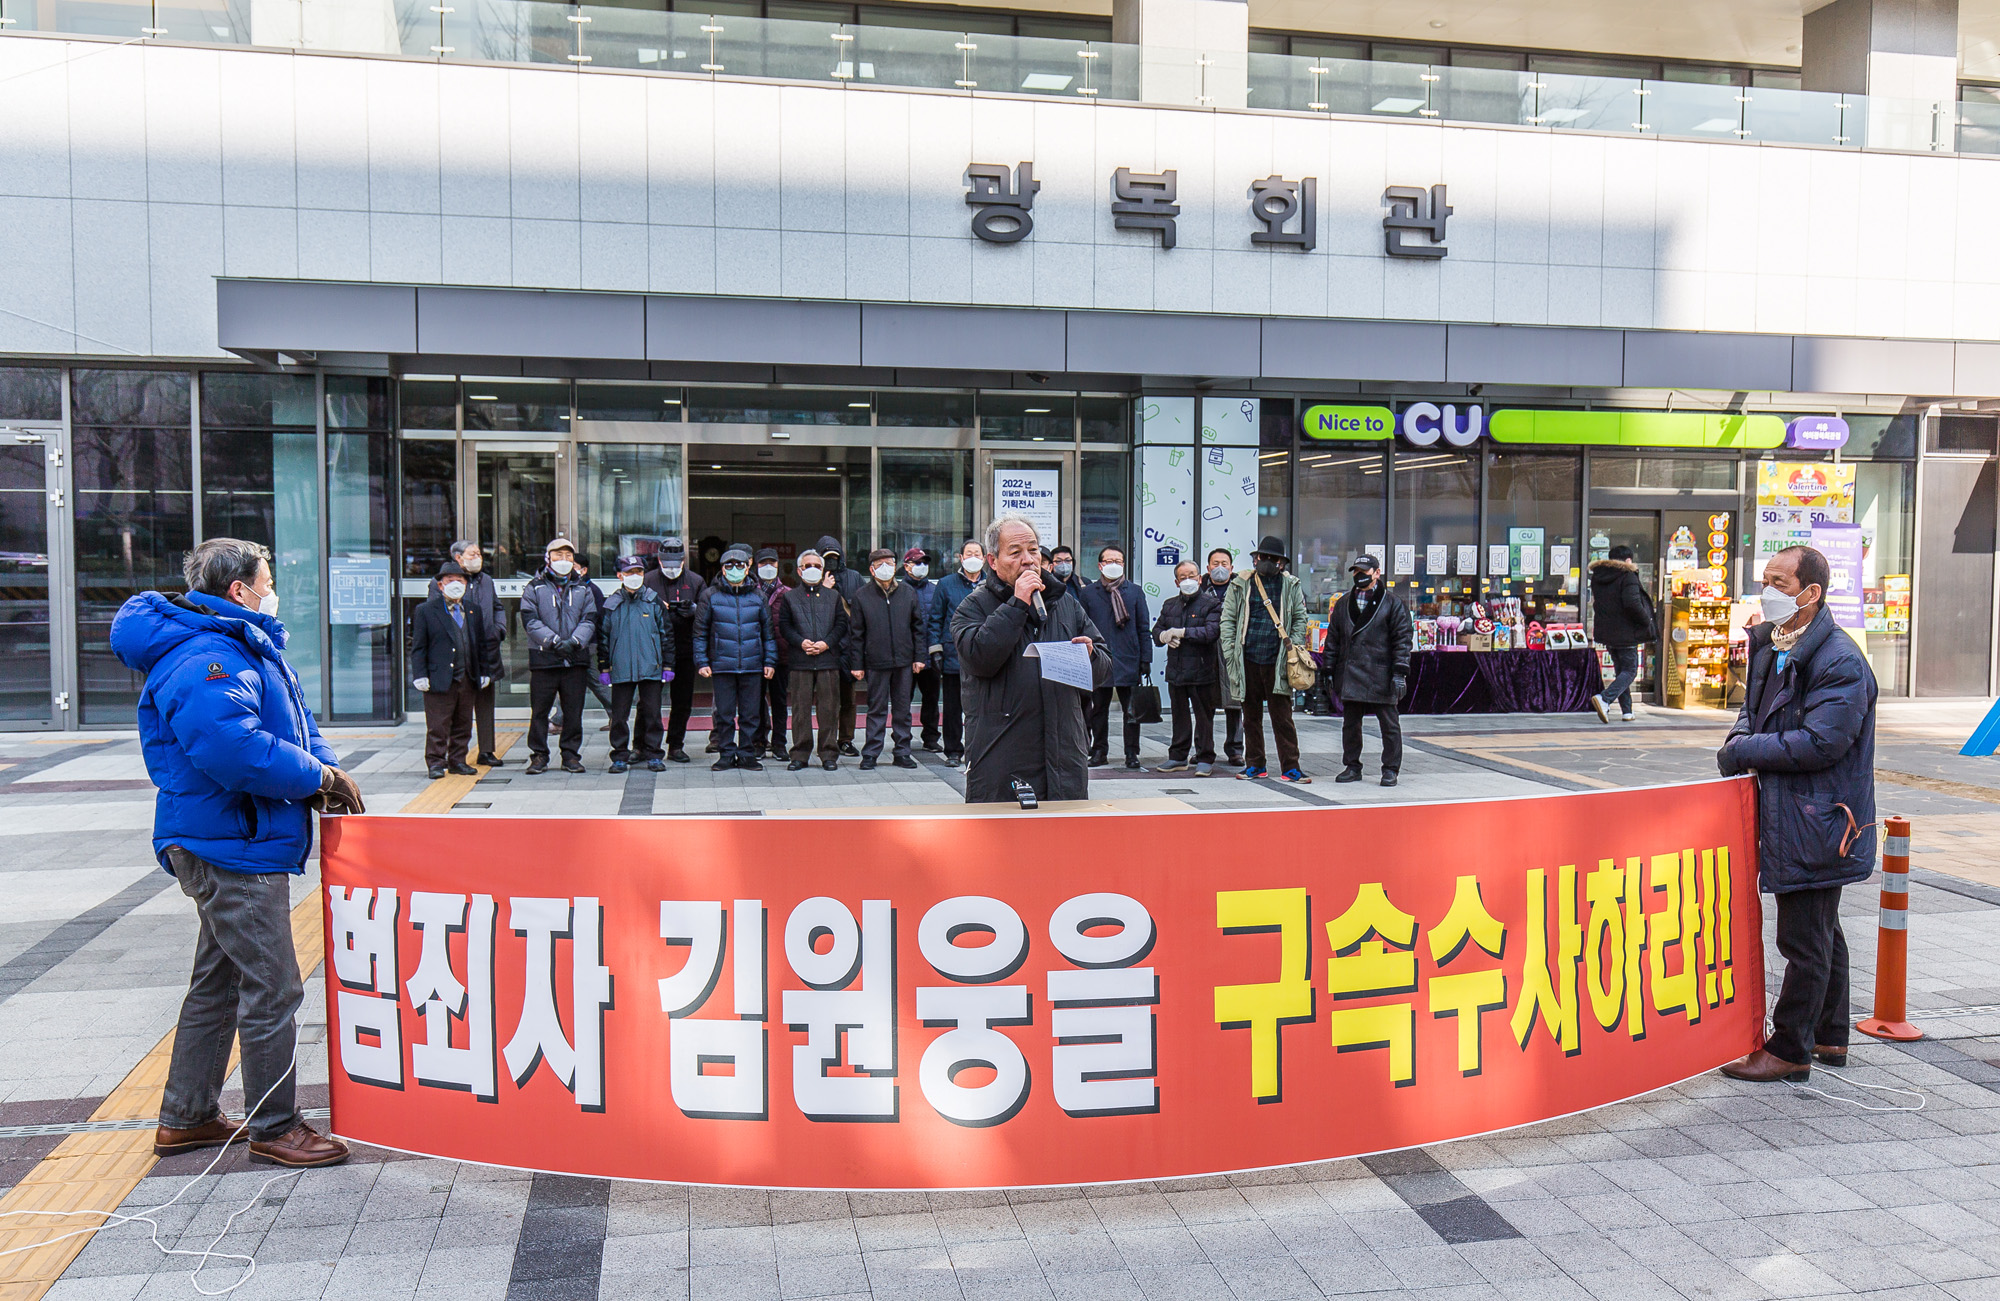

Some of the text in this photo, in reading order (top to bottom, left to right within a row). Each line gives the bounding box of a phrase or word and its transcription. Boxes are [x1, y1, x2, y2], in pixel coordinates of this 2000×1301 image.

[963, 162, 1454, 259] 광복회관
[1319, 402, 1482, 446] Nice to CU
[1203, 428, 1214, 437] CU
[1788, 483, 1828, 491] Valentine
[1022, 490, 1053, 498] 독립운동가
[1002, 500, 1035, 508] 기획전시
[1144, 527, 1165, 542] CU
[1162, 555, 1173, 564] 15
[1146, 584, 1158, 593] CU
[329, 885, 614, 1113] 범죄자
[658, 892, 1160, 1128] 김원웅을
